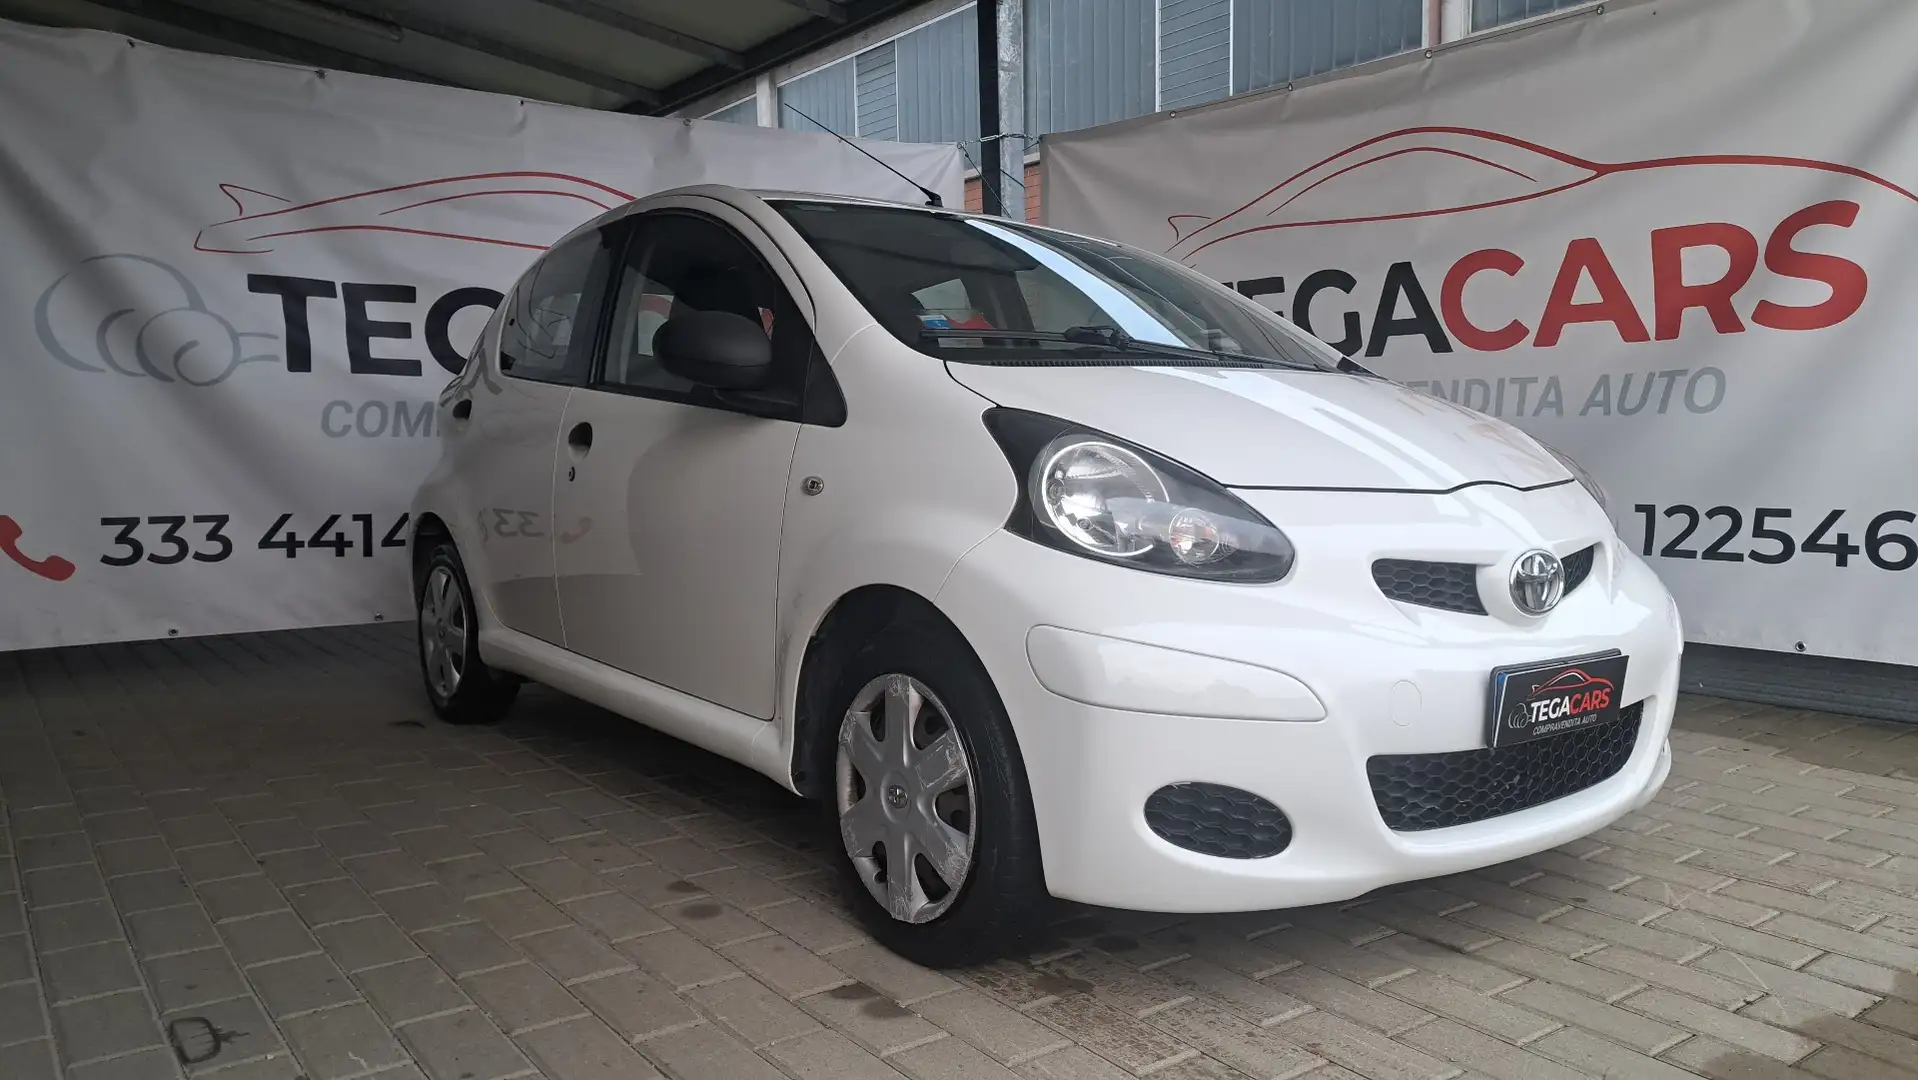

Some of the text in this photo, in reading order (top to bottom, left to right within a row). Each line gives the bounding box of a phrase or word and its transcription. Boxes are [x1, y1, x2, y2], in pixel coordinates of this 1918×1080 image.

[1222, 200, 1868, 359] GACARS
[1579, 366, 1727, 417] AUTO
[320, 399, 441, 438] COM
[100, 514, 233, 566] 333
[1634, 503, 1918, 571] 122546
[1530, 687, 1611, 723] TEGACARS
[1532, 713, 1598, 735] COMPRAVENDITA AUTO
